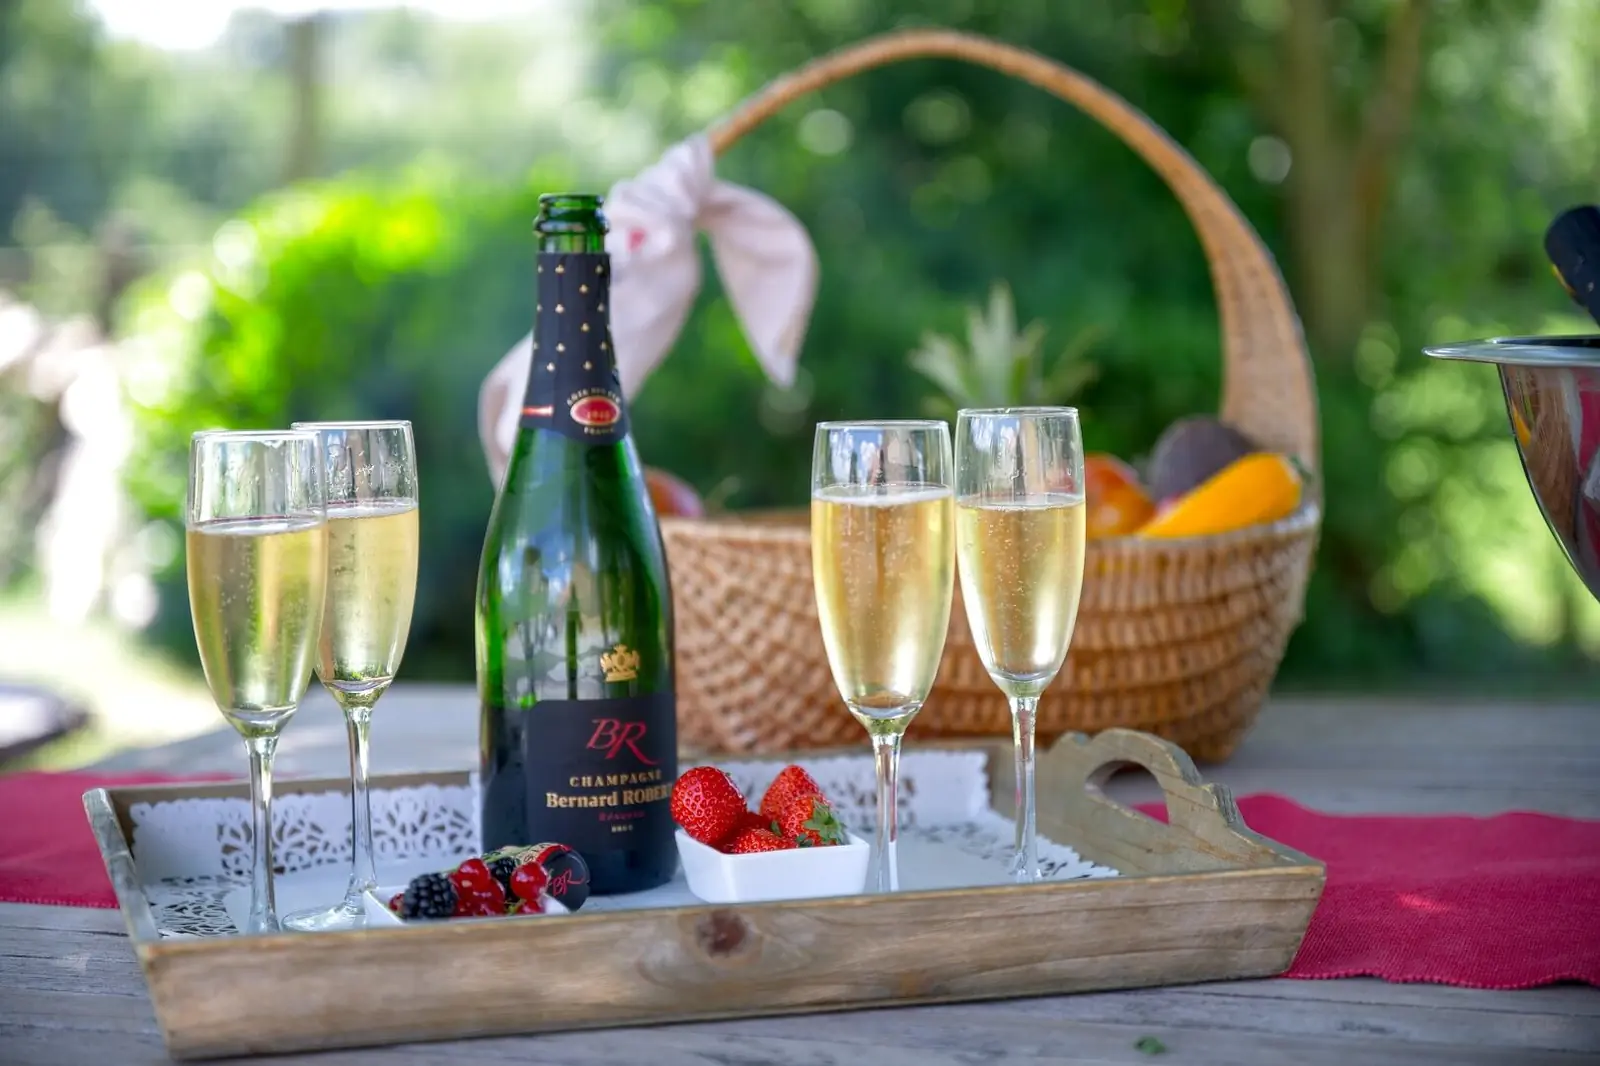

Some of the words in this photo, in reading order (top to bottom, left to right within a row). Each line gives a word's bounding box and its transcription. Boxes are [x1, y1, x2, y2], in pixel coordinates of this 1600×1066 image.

[586, 718, 662, 765] BR
[569, 769, 662, 788] CHAMPAGNE
[546, 792, 618, 808] Bernard
